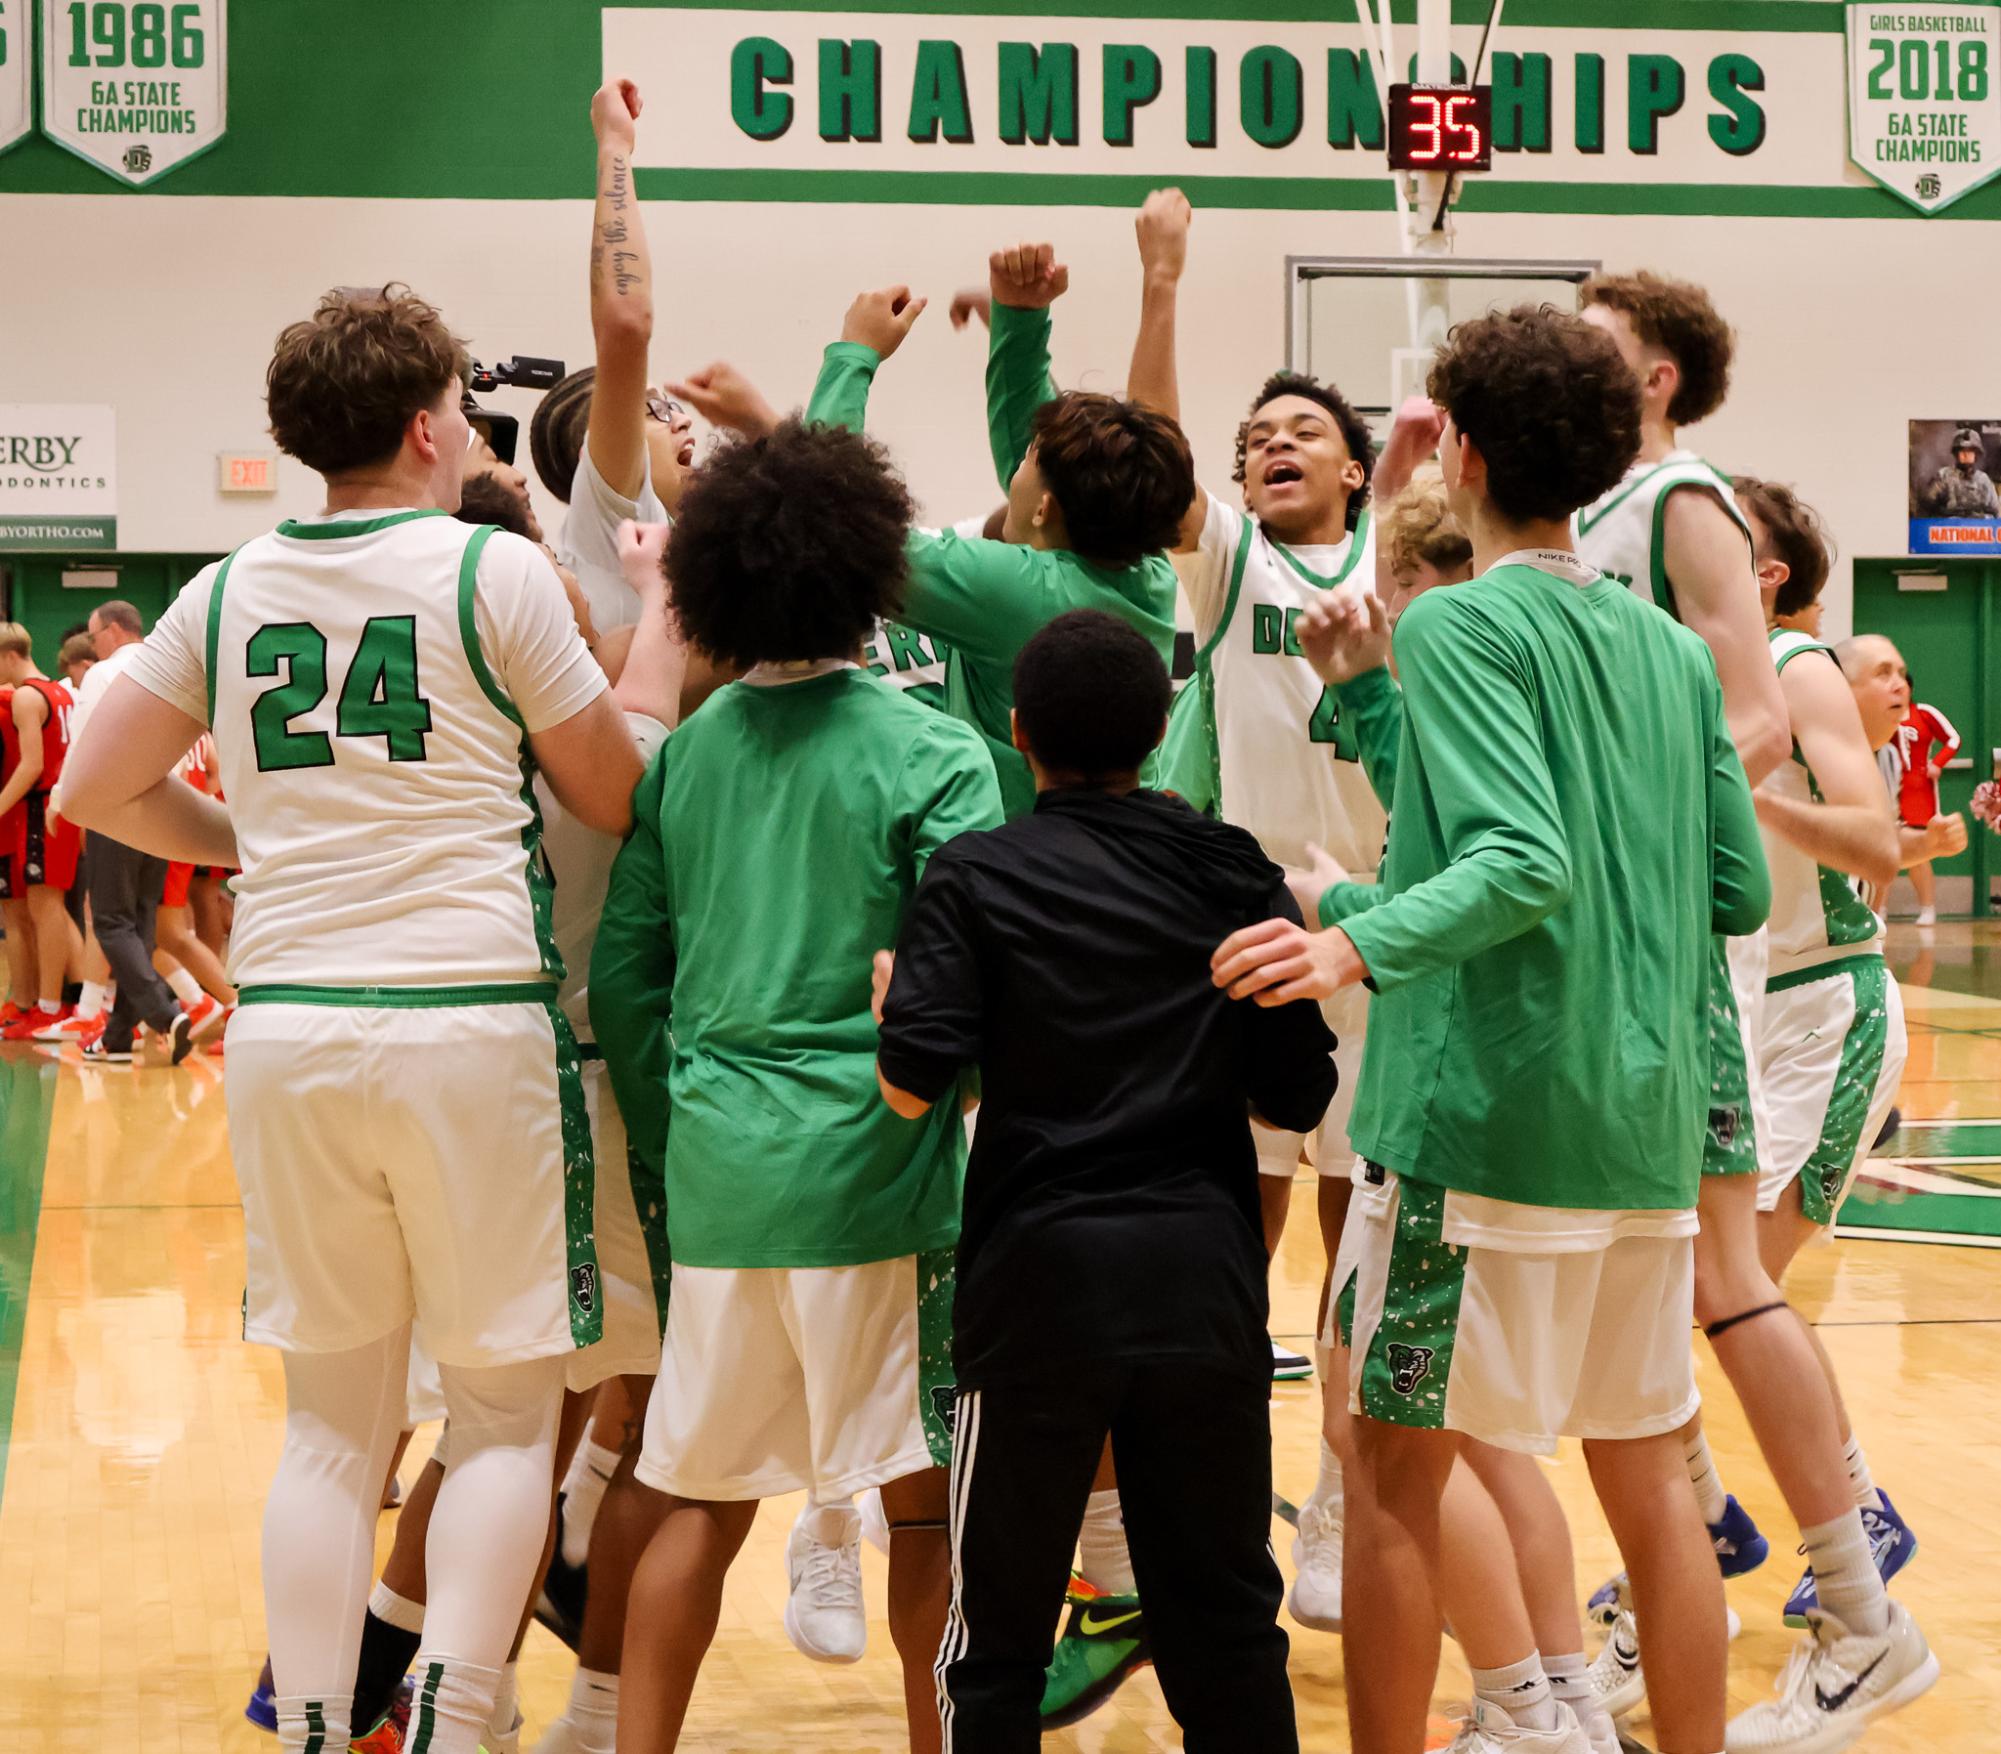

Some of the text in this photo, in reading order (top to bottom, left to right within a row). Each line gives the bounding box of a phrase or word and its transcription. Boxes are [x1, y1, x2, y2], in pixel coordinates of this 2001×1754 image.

[67, 2, 204, 68] 1986
[1870, 15, 1987, 32] GIRLS BASKETBALL
[1868, 38, 1988, 101] 2018
[91, 81, 181, 106] 6A STATE
[730, 35, 1766, 156] CHAMPIONHIPS
[77, 108, 196, 134] CHAMPIONS
[1409, 95, 1480, 159] 35
[1888, 113, 1968, 137] 6A STATE
[1876, 139, 1981, 162] CHAMPIONS
[602, 154, 642, 296] enjoy the silence
[0, 477, 106, 488] DONTICS
[231, 460, 268, 486] EXIT
[1929, 526, 1994, 544] NATIONAL
[1538, 553, 1566, 563] NIKE
[246, 614, 432, 772] 24
